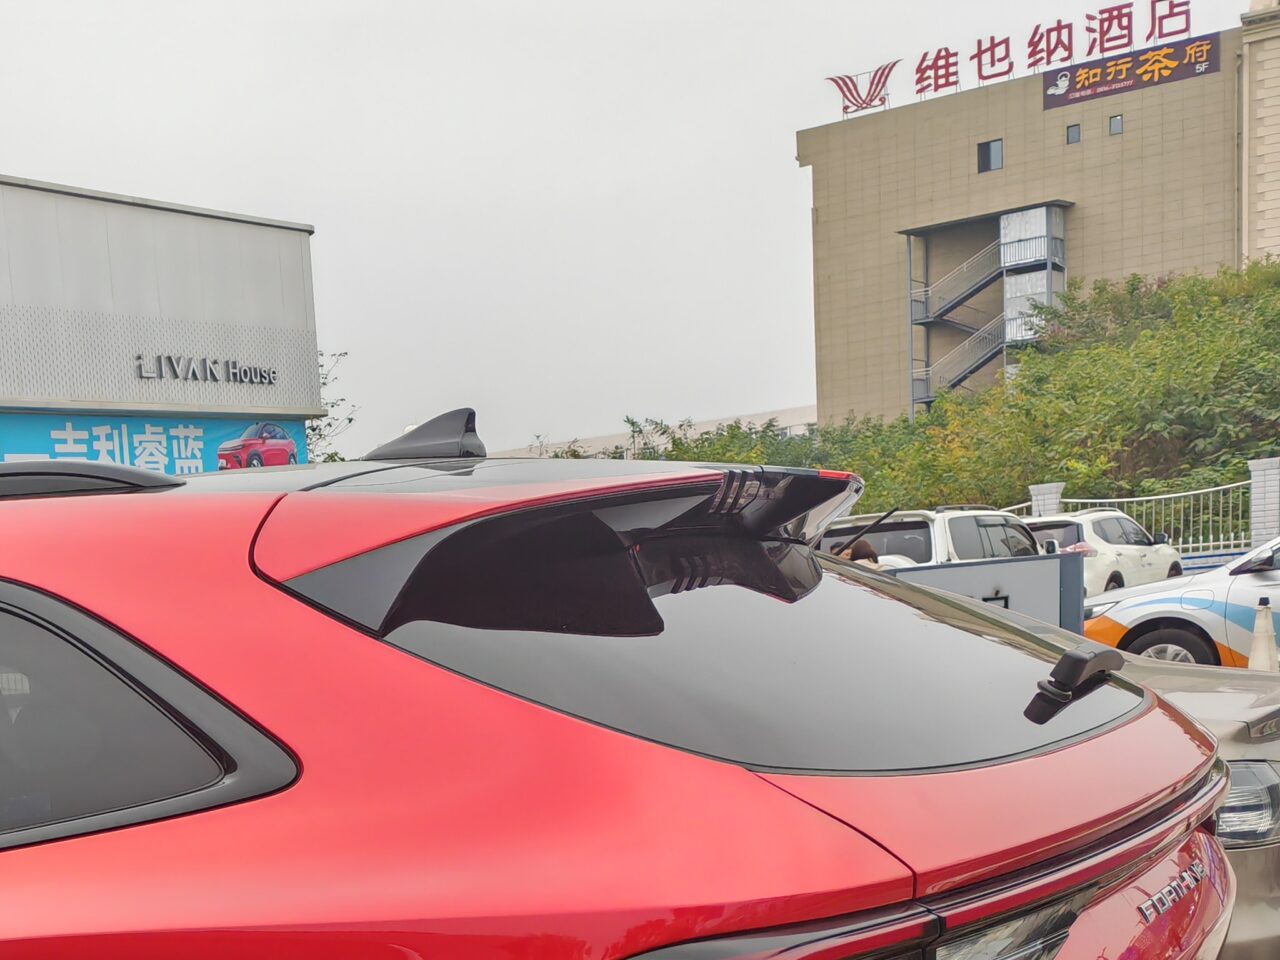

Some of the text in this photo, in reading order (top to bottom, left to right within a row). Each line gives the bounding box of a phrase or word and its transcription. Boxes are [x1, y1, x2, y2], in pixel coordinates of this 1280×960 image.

[914, 0, 1193, 95] 维也纳酒店
[1075, 40, 1213, 90] 知行茶府
[1195, 62, 1210, 74] 5F
[135, 354, 279, 385] LIVAN House
